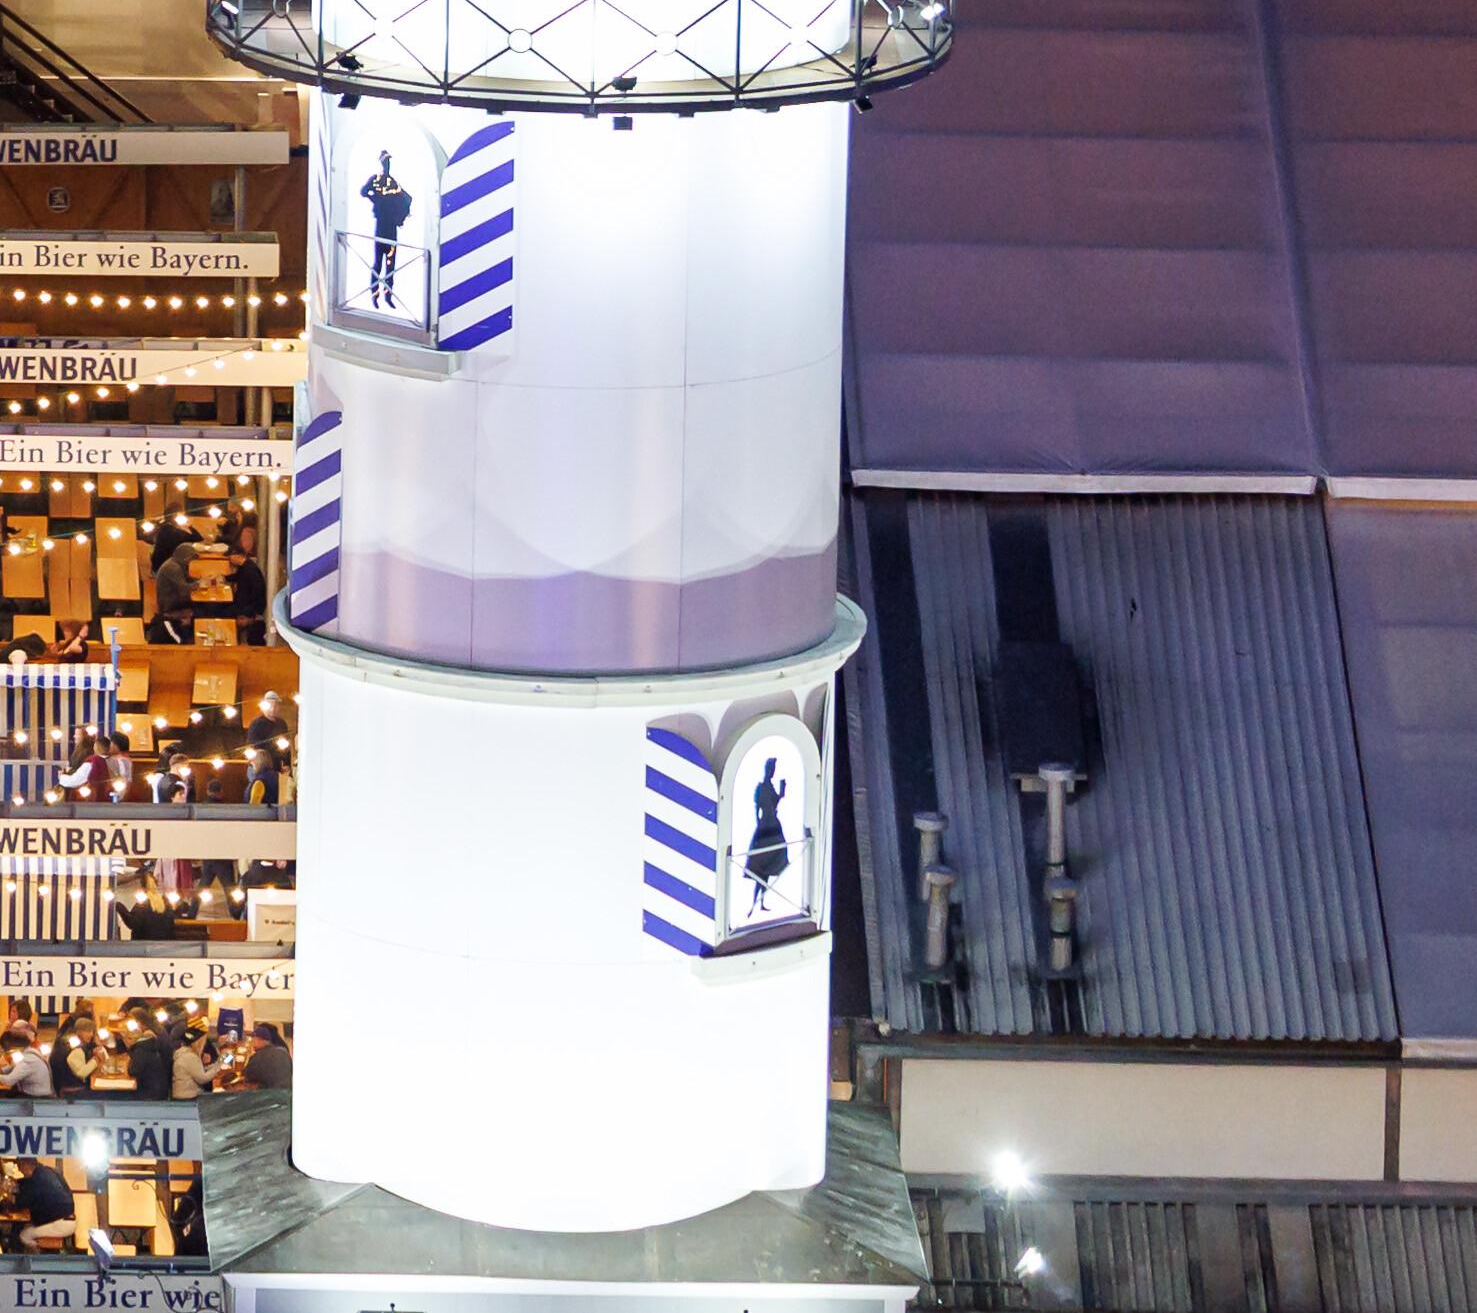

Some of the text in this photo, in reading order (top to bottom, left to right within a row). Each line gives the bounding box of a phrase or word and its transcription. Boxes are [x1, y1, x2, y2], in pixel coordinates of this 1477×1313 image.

[33, 245, 89, 268] Bier
[95, 246, 142, 269] wie
[150, 246, 250, 277] Bayern.
[0, 438, 45, 463] Ein
[68, 440, 113, 465] Bier
[121, 442, 168, 467] wie
[178, 442, 282, 473] Bayern.
[1, 961, 54, 988] Ein
[67, 962, 129, 989] Bier
[141, 964, 195, 990] wie
[13, 1278, 71, 1308] Ein
[84, 1278, 153, 1309] Bier
